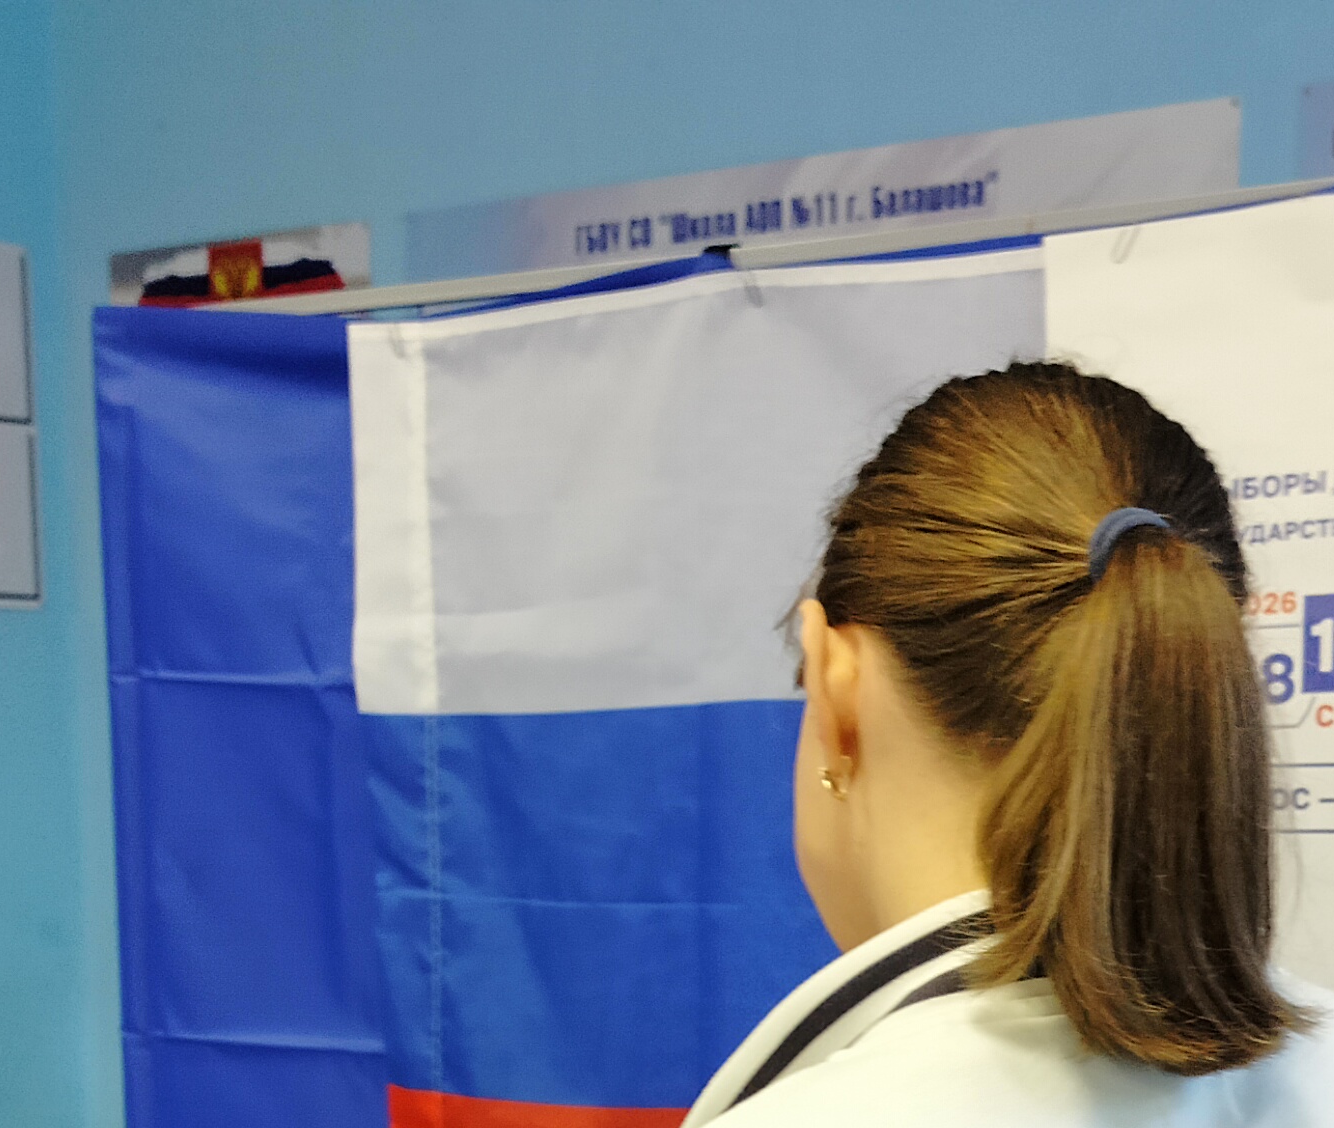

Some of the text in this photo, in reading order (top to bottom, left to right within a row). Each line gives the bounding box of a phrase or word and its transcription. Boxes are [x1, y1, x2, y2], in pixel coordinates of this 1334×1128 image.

[1228, 471, 1327, 501] БОРЫ
[1247, 591, 1297, 616] 026
[1263, 653, 1295, 705] 8
